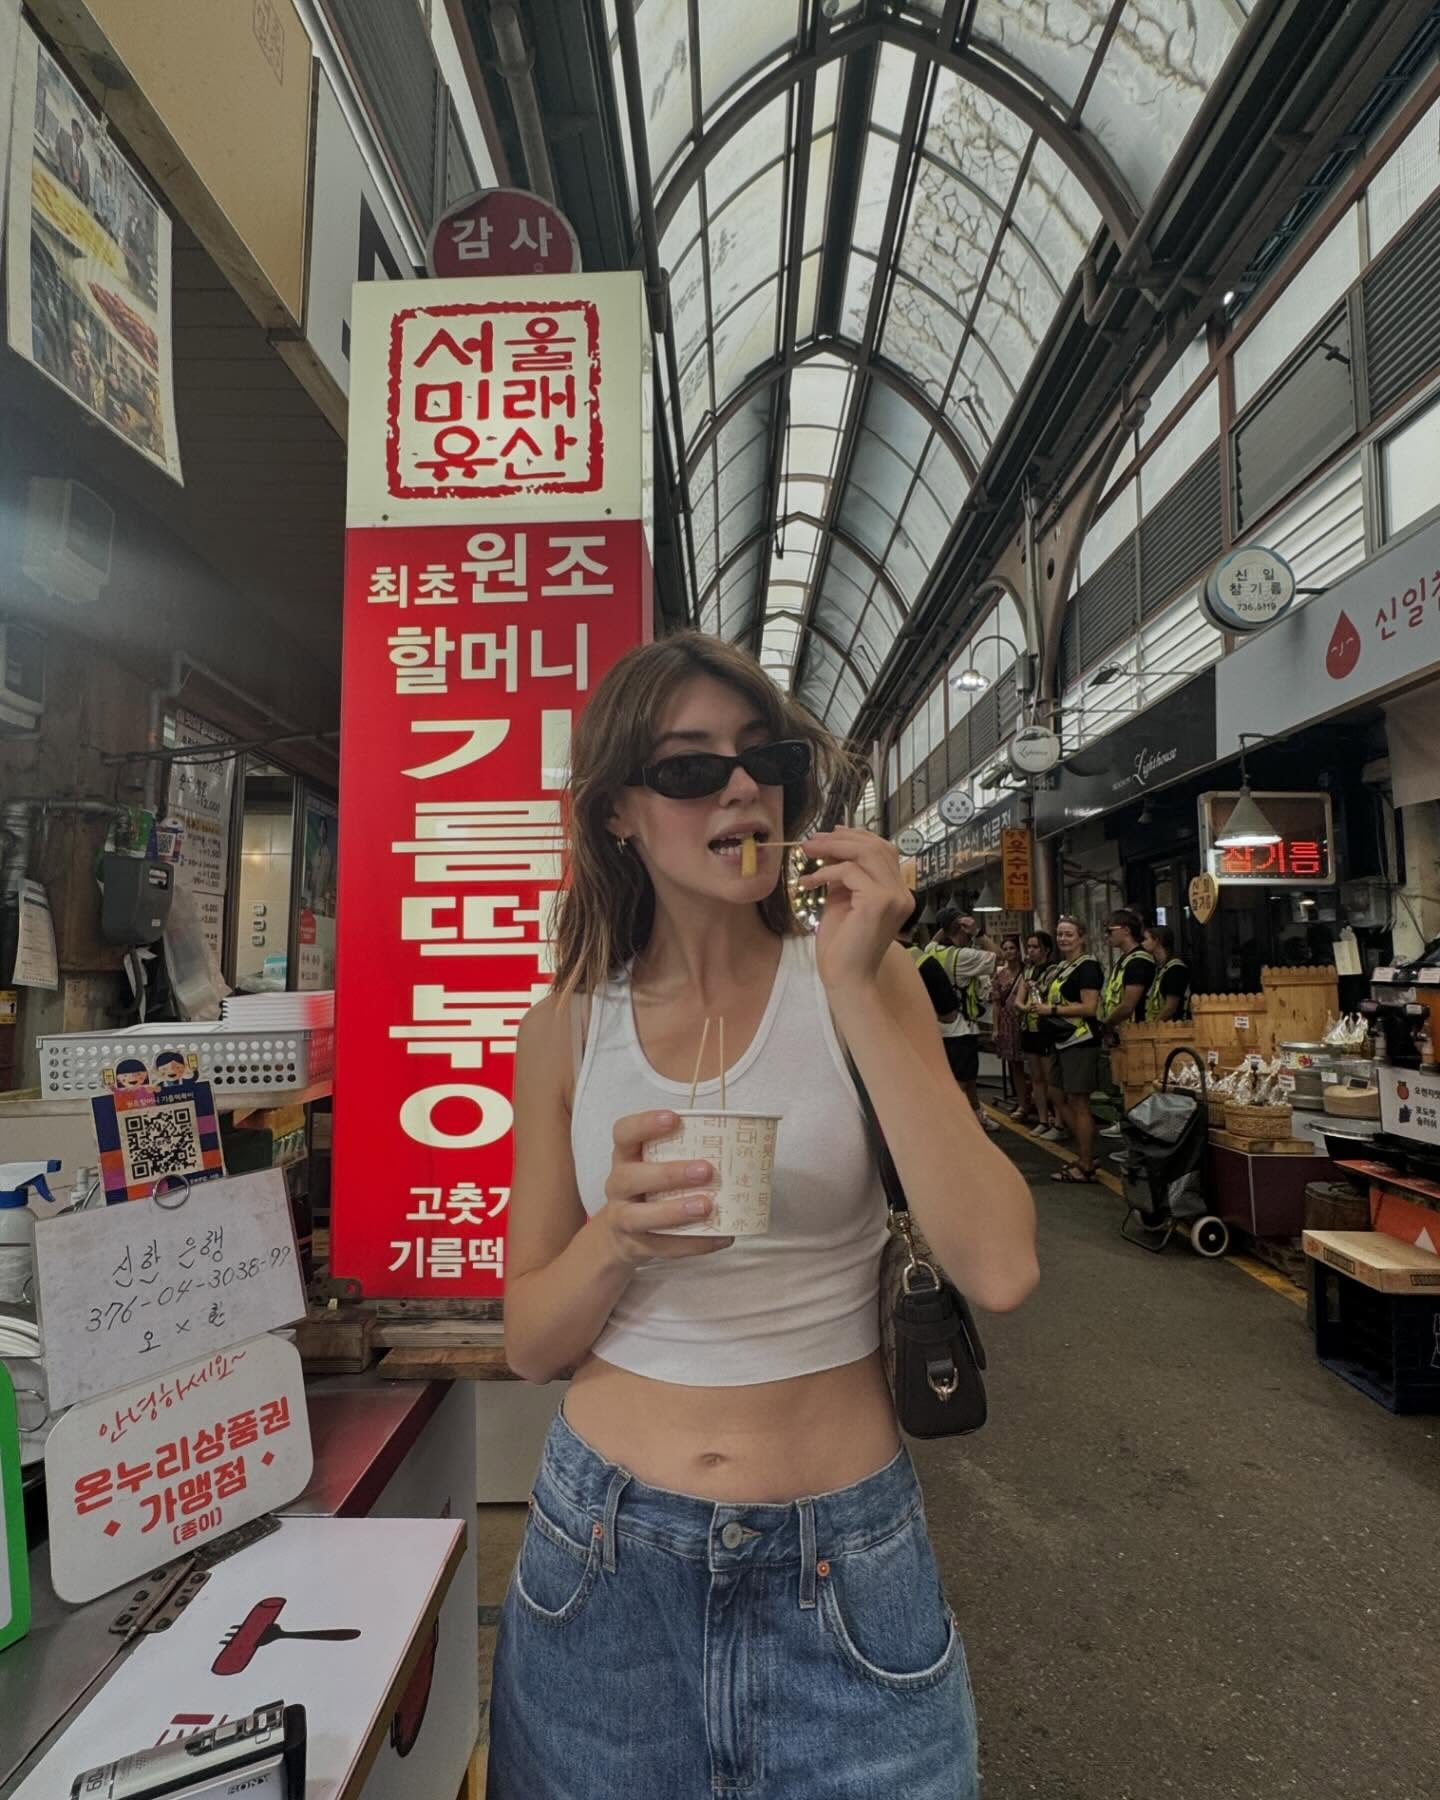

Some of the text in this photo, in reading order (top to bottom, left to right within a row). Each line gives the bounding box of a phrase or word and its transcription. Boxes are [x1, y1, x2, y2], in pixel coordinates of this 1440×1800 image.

[414, 316, 577, 373] 서울
[414, 374, 576, 423] 미래
[413, 423, 578, 482] 유산
[367, 532, 614, 609] 최초 원조
[387, 622, 589, 695] 할머니
[112, 1225, 224, 1288] 신한 은행
[74, 1395, 291, 1516] 온누리상품권
[139, 1455, 248, 1534] 가맹점
